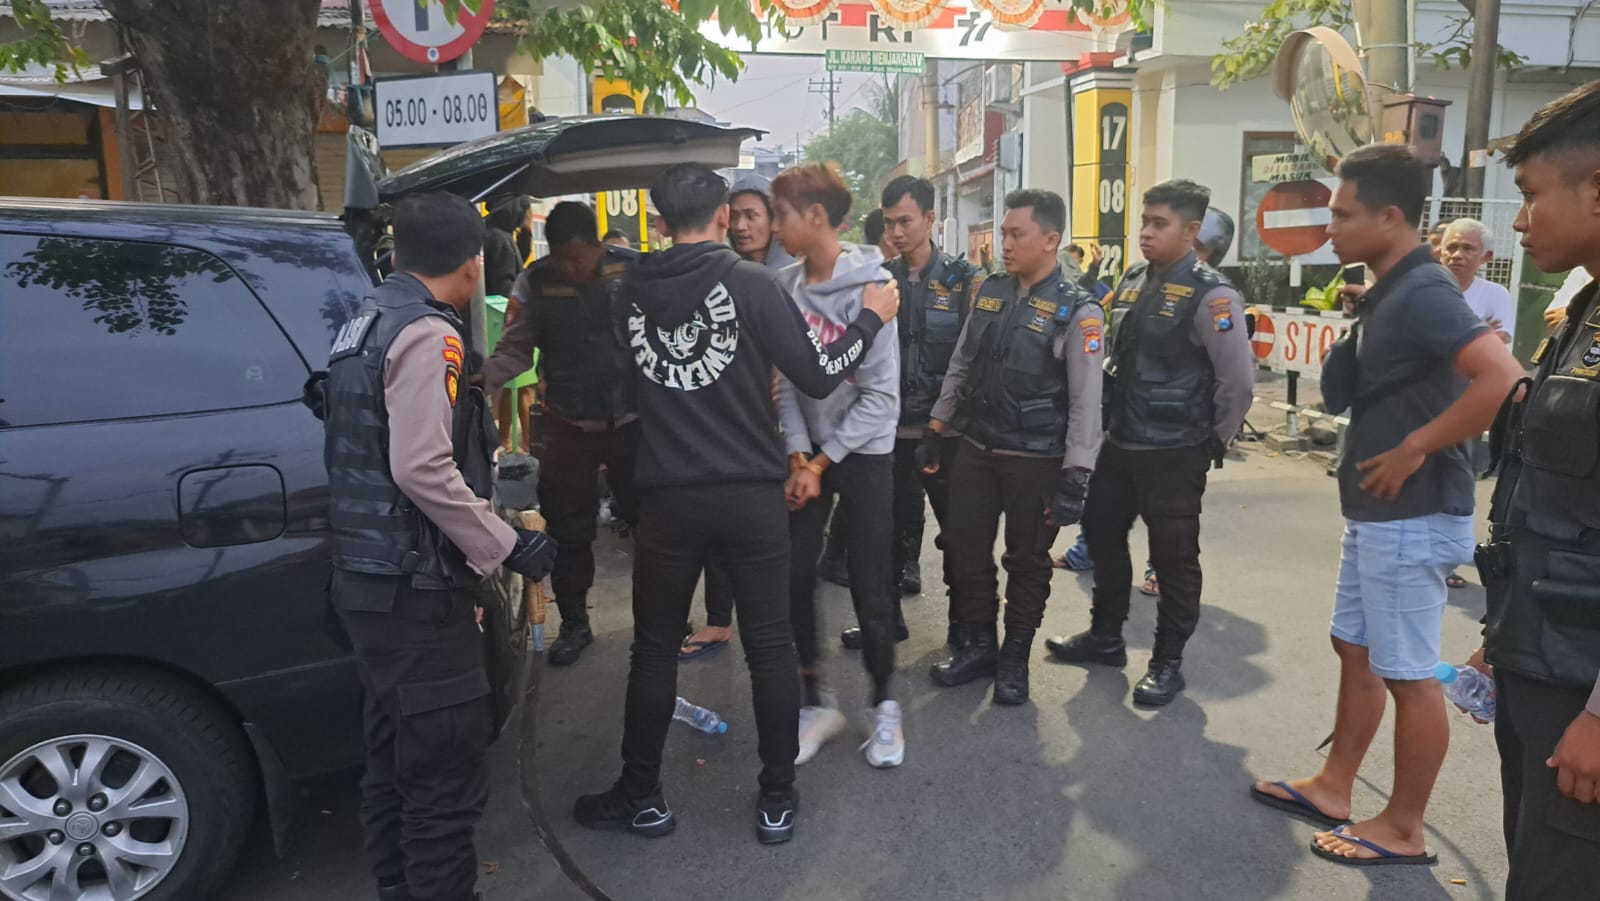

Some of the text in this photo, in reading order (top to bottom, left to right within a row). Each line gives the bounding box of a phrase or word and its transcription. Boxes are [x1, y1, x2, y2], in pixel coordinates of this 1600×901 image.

[841, 50, 871, 66] KARANG
[386, 98, 427, 128] 05.00
[443, 92, 488, 124] 08.00
[1102, 115, 1127, 151] 17
[1099, 178, 1125, 215] 08
[1284, 320, 1350, 366] STO
